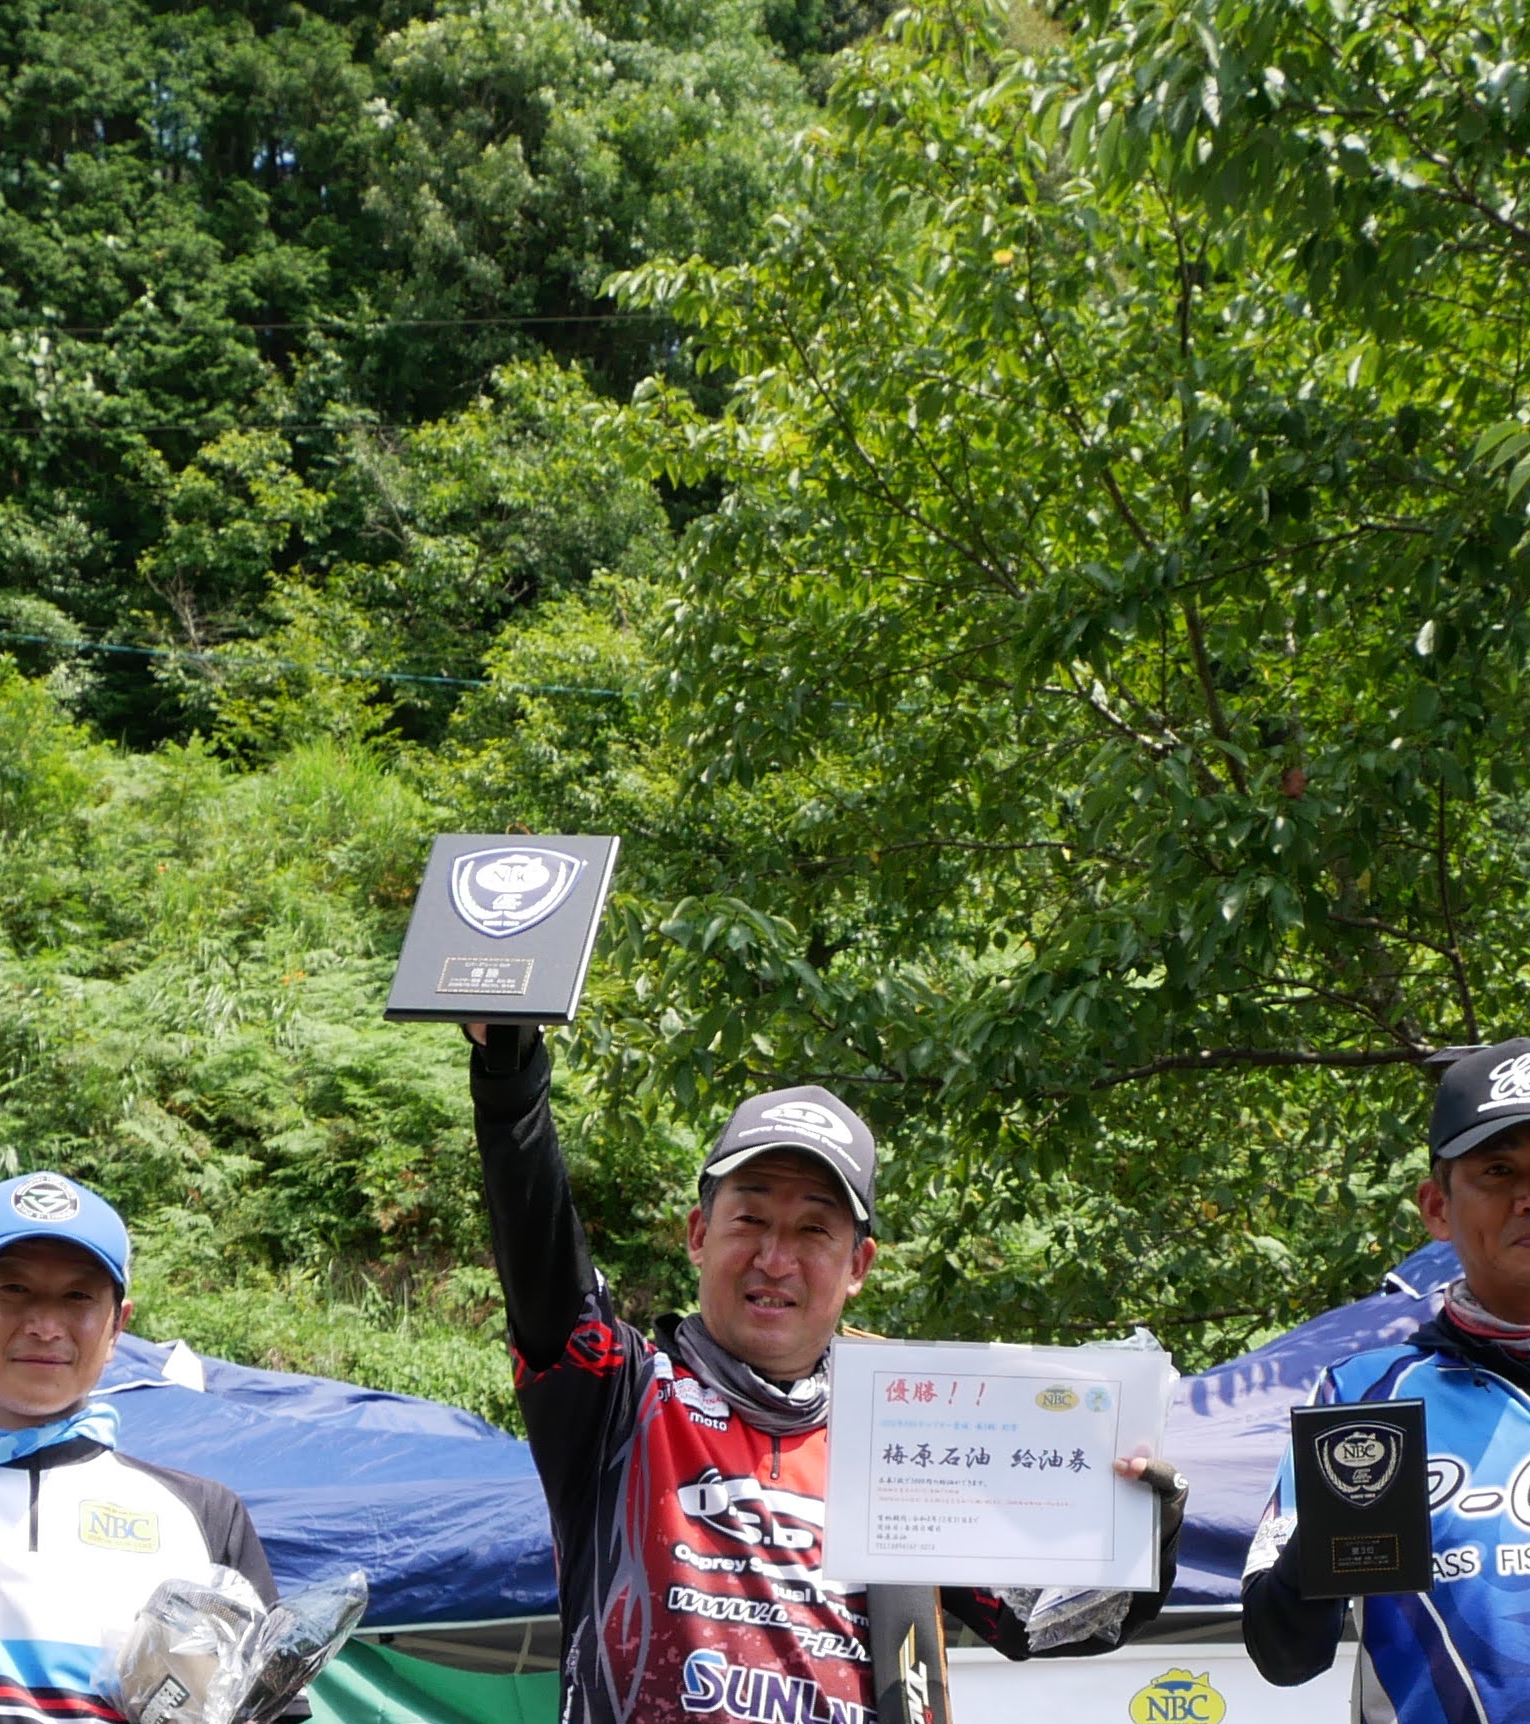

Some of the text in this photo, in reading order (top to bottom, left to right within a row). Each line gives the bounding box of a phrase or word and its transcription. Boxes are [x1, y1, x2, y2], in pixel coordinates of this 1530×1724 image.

[1042, 1392, 1072, 1406] NBC
[882, 1443, 1091, 1473] 梅原石油 給油券
[1343, 1444, 1375, 1459] NBC
[89, 1511, 151, 1541] NBC
[1432, 1551, 1476, 1579] ASS
[1146, 1694, 1210, 1722] NBC
